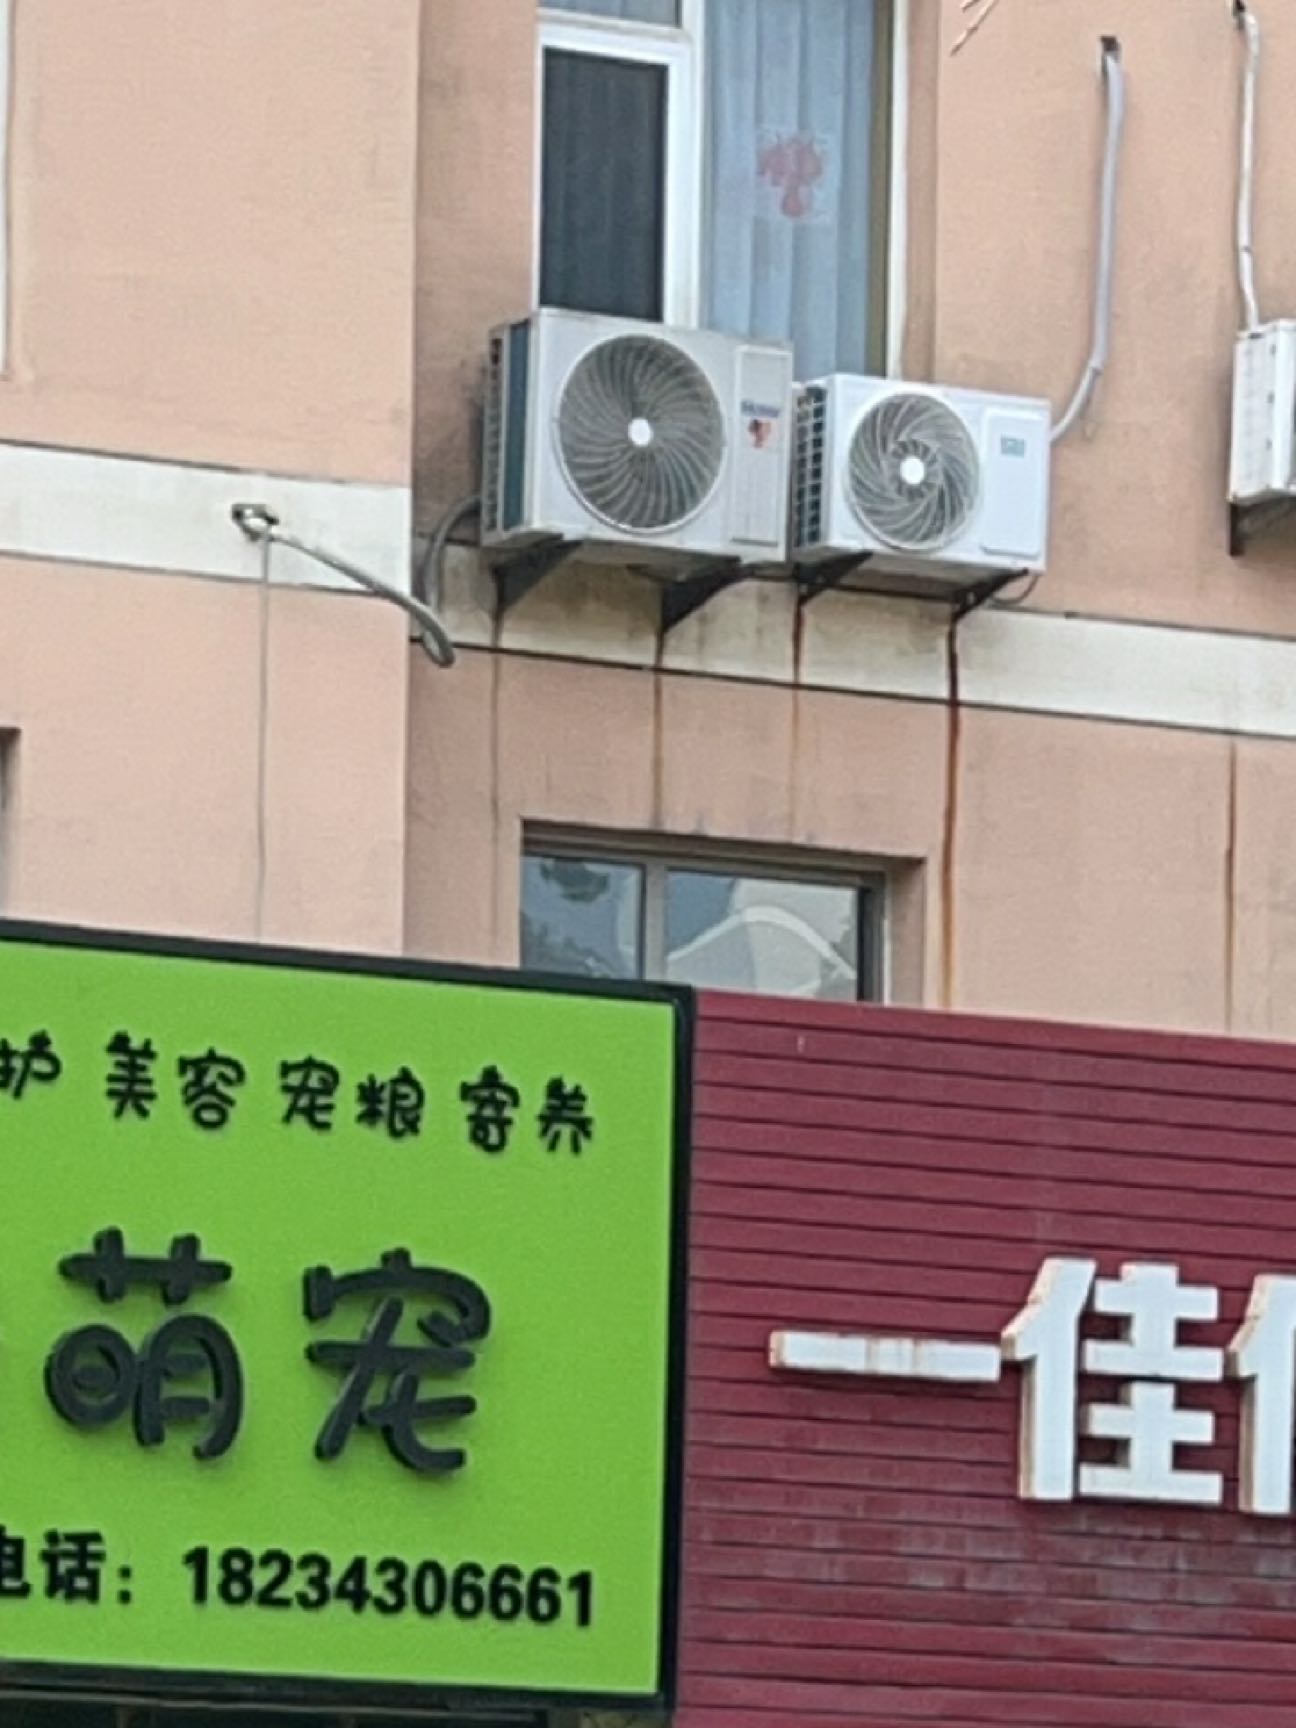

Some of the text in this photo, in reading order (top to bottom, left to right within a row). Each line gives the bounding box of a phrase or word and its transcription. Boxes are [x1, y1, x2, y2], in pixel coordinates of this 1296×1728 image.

[106, 1032, 247, 1130] 美容
[279, 1055, 426, 1139] 宠粮
[460, 1065, 594, 1154] 寄养
[184, 1547, 593, 1629] 18234306661
